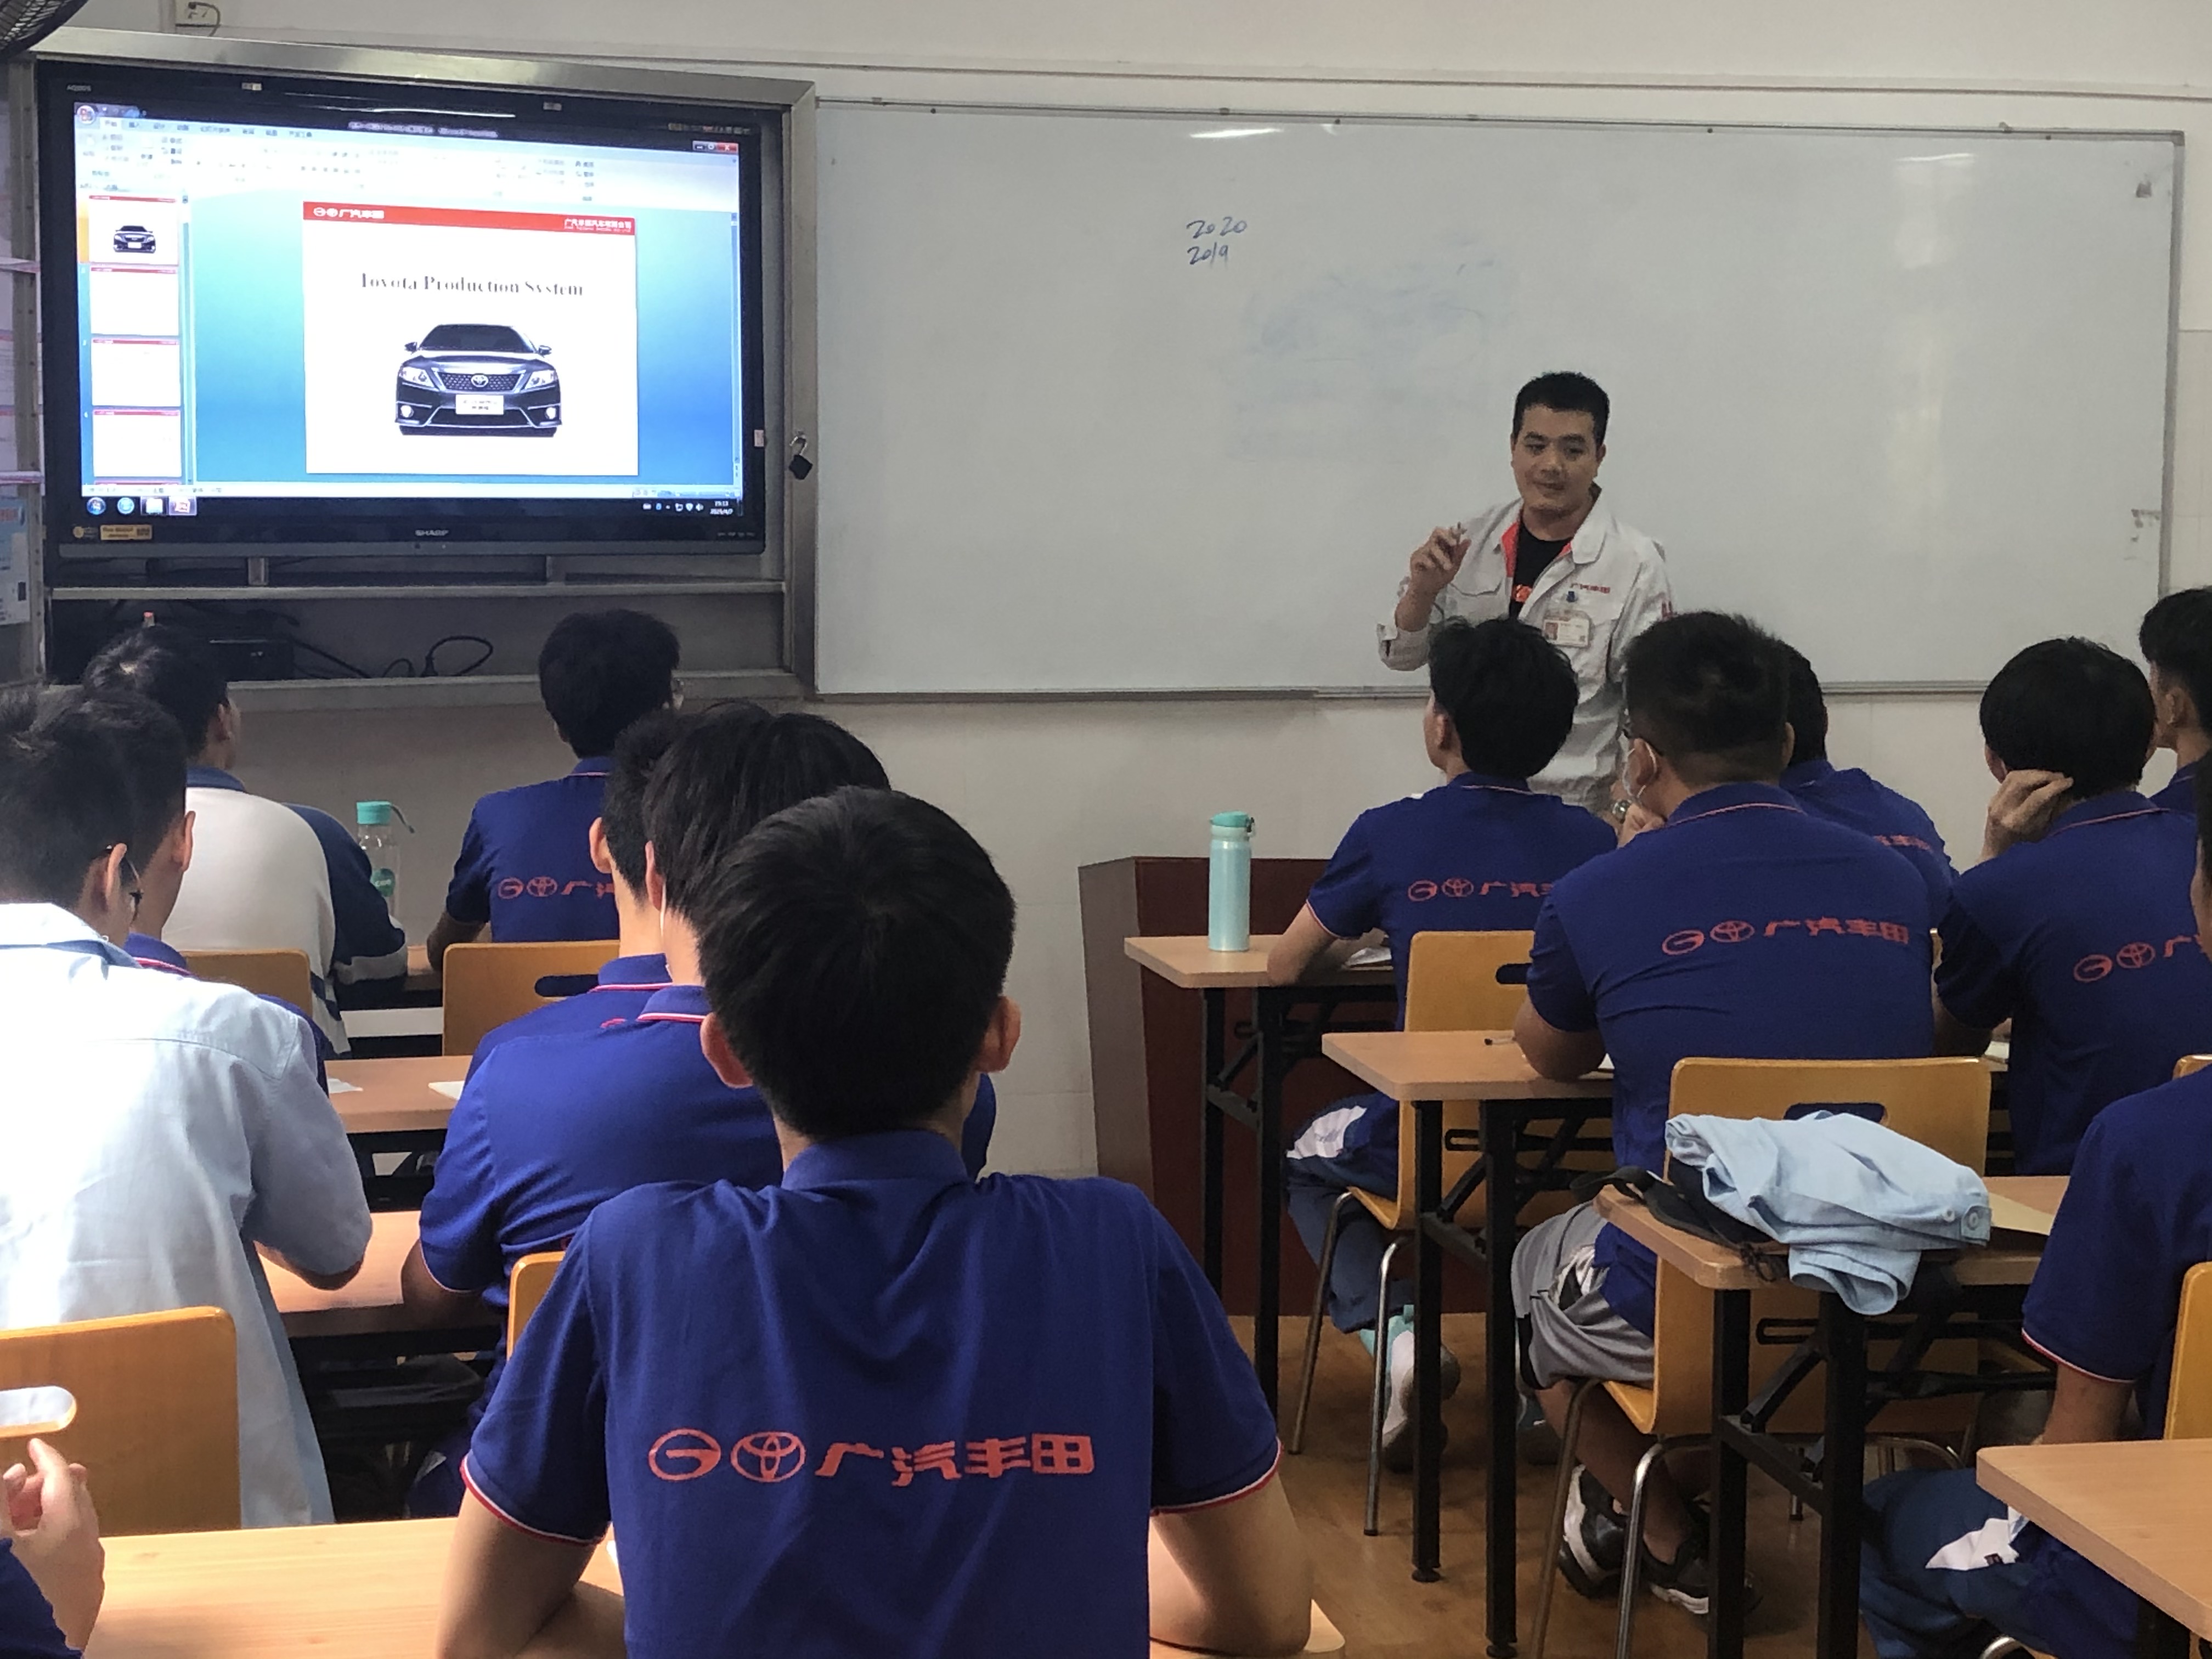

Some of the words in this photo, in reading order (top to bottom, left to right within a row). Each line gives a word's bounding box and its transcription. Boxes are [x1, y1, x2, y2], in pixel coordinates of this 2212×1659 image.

[1186, 216, 1248, 239] 2020
[1187, 241, 1229, 268] 2019
[425, 275, 519, 294] Production
[525, 280, 583, 296] System
[1763, 916, 1910, 945] 广汽丰田
[814, 1432, 1095, 1487] 广汽丰田
